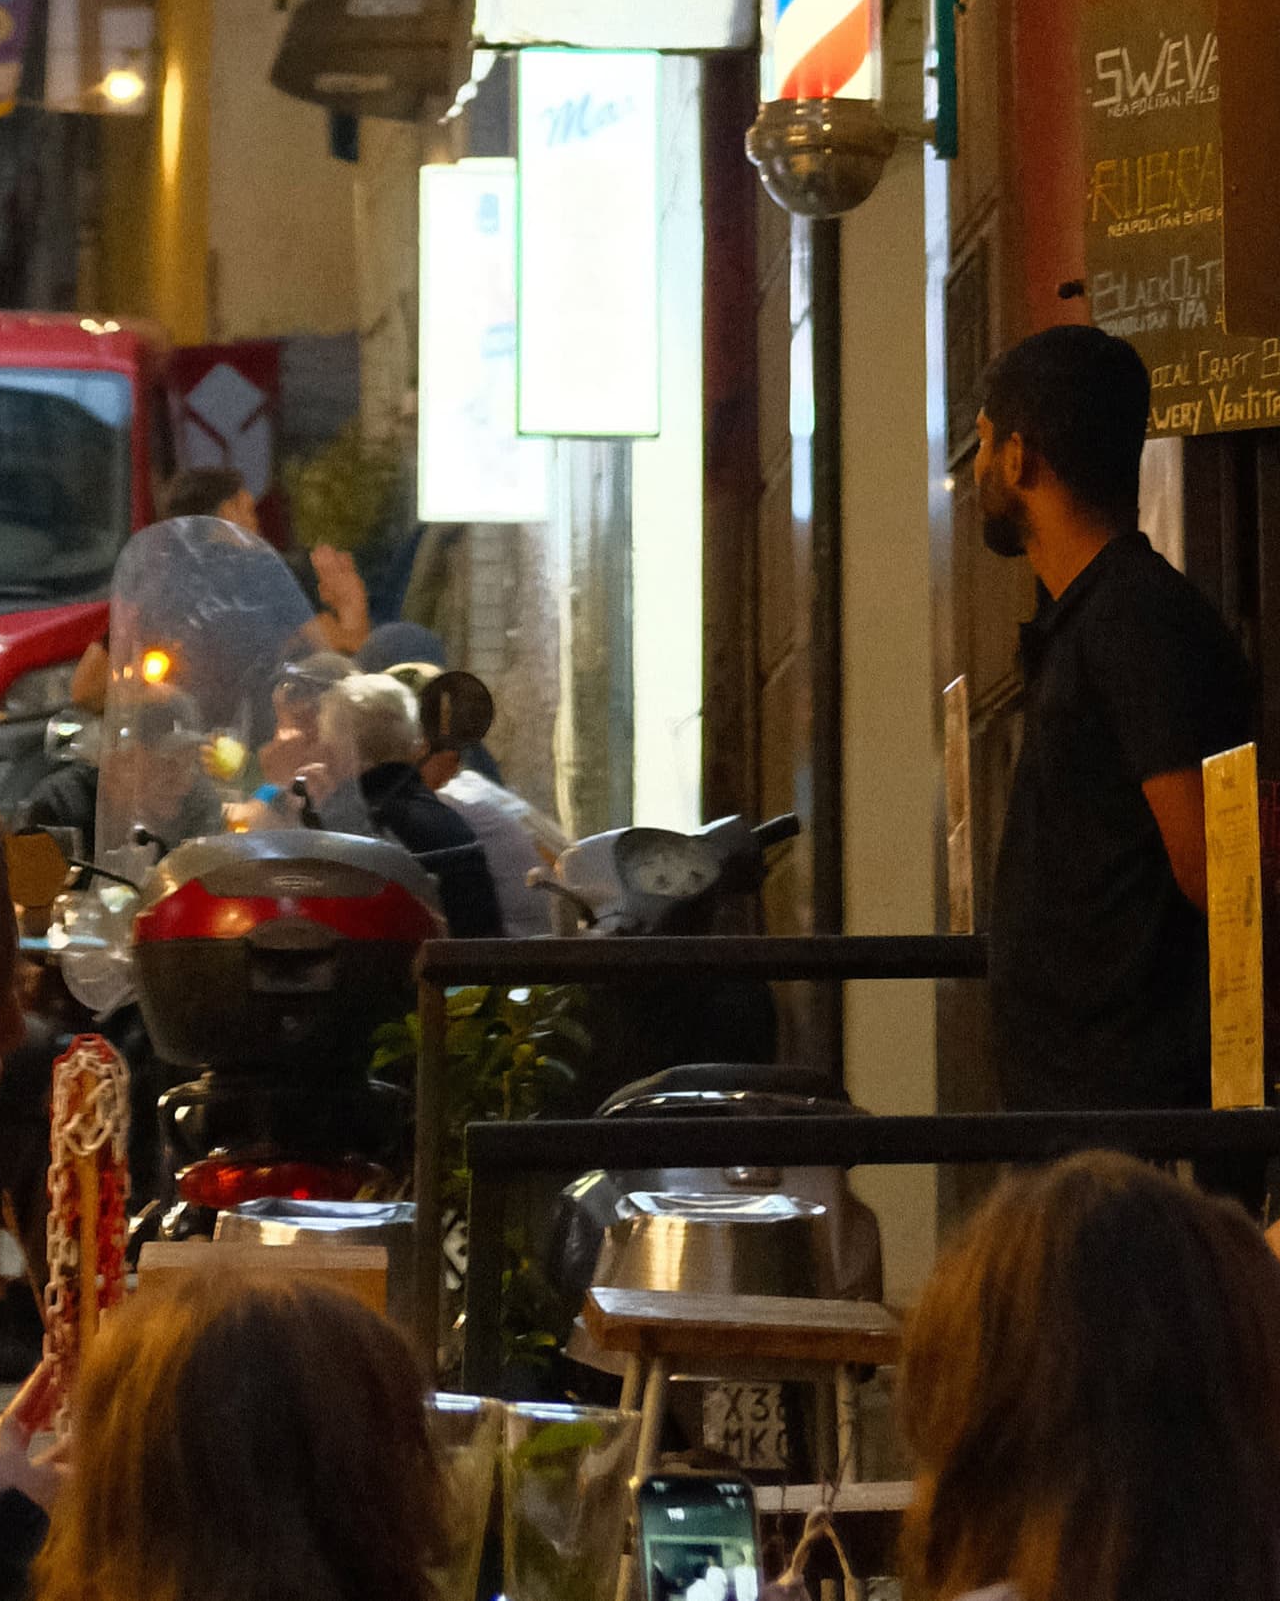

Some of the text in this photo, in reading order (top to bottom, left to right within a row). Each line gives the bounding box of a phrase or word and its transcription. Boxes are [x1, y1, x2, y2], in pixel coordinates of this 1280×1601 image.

[1184, 206, 1223, 226] BITTE
[1178, 300, 1207, 329] IPA
[1150, 359, 1193, 390] OCAL
[1198, 349, 1255, 386] CRAFT
